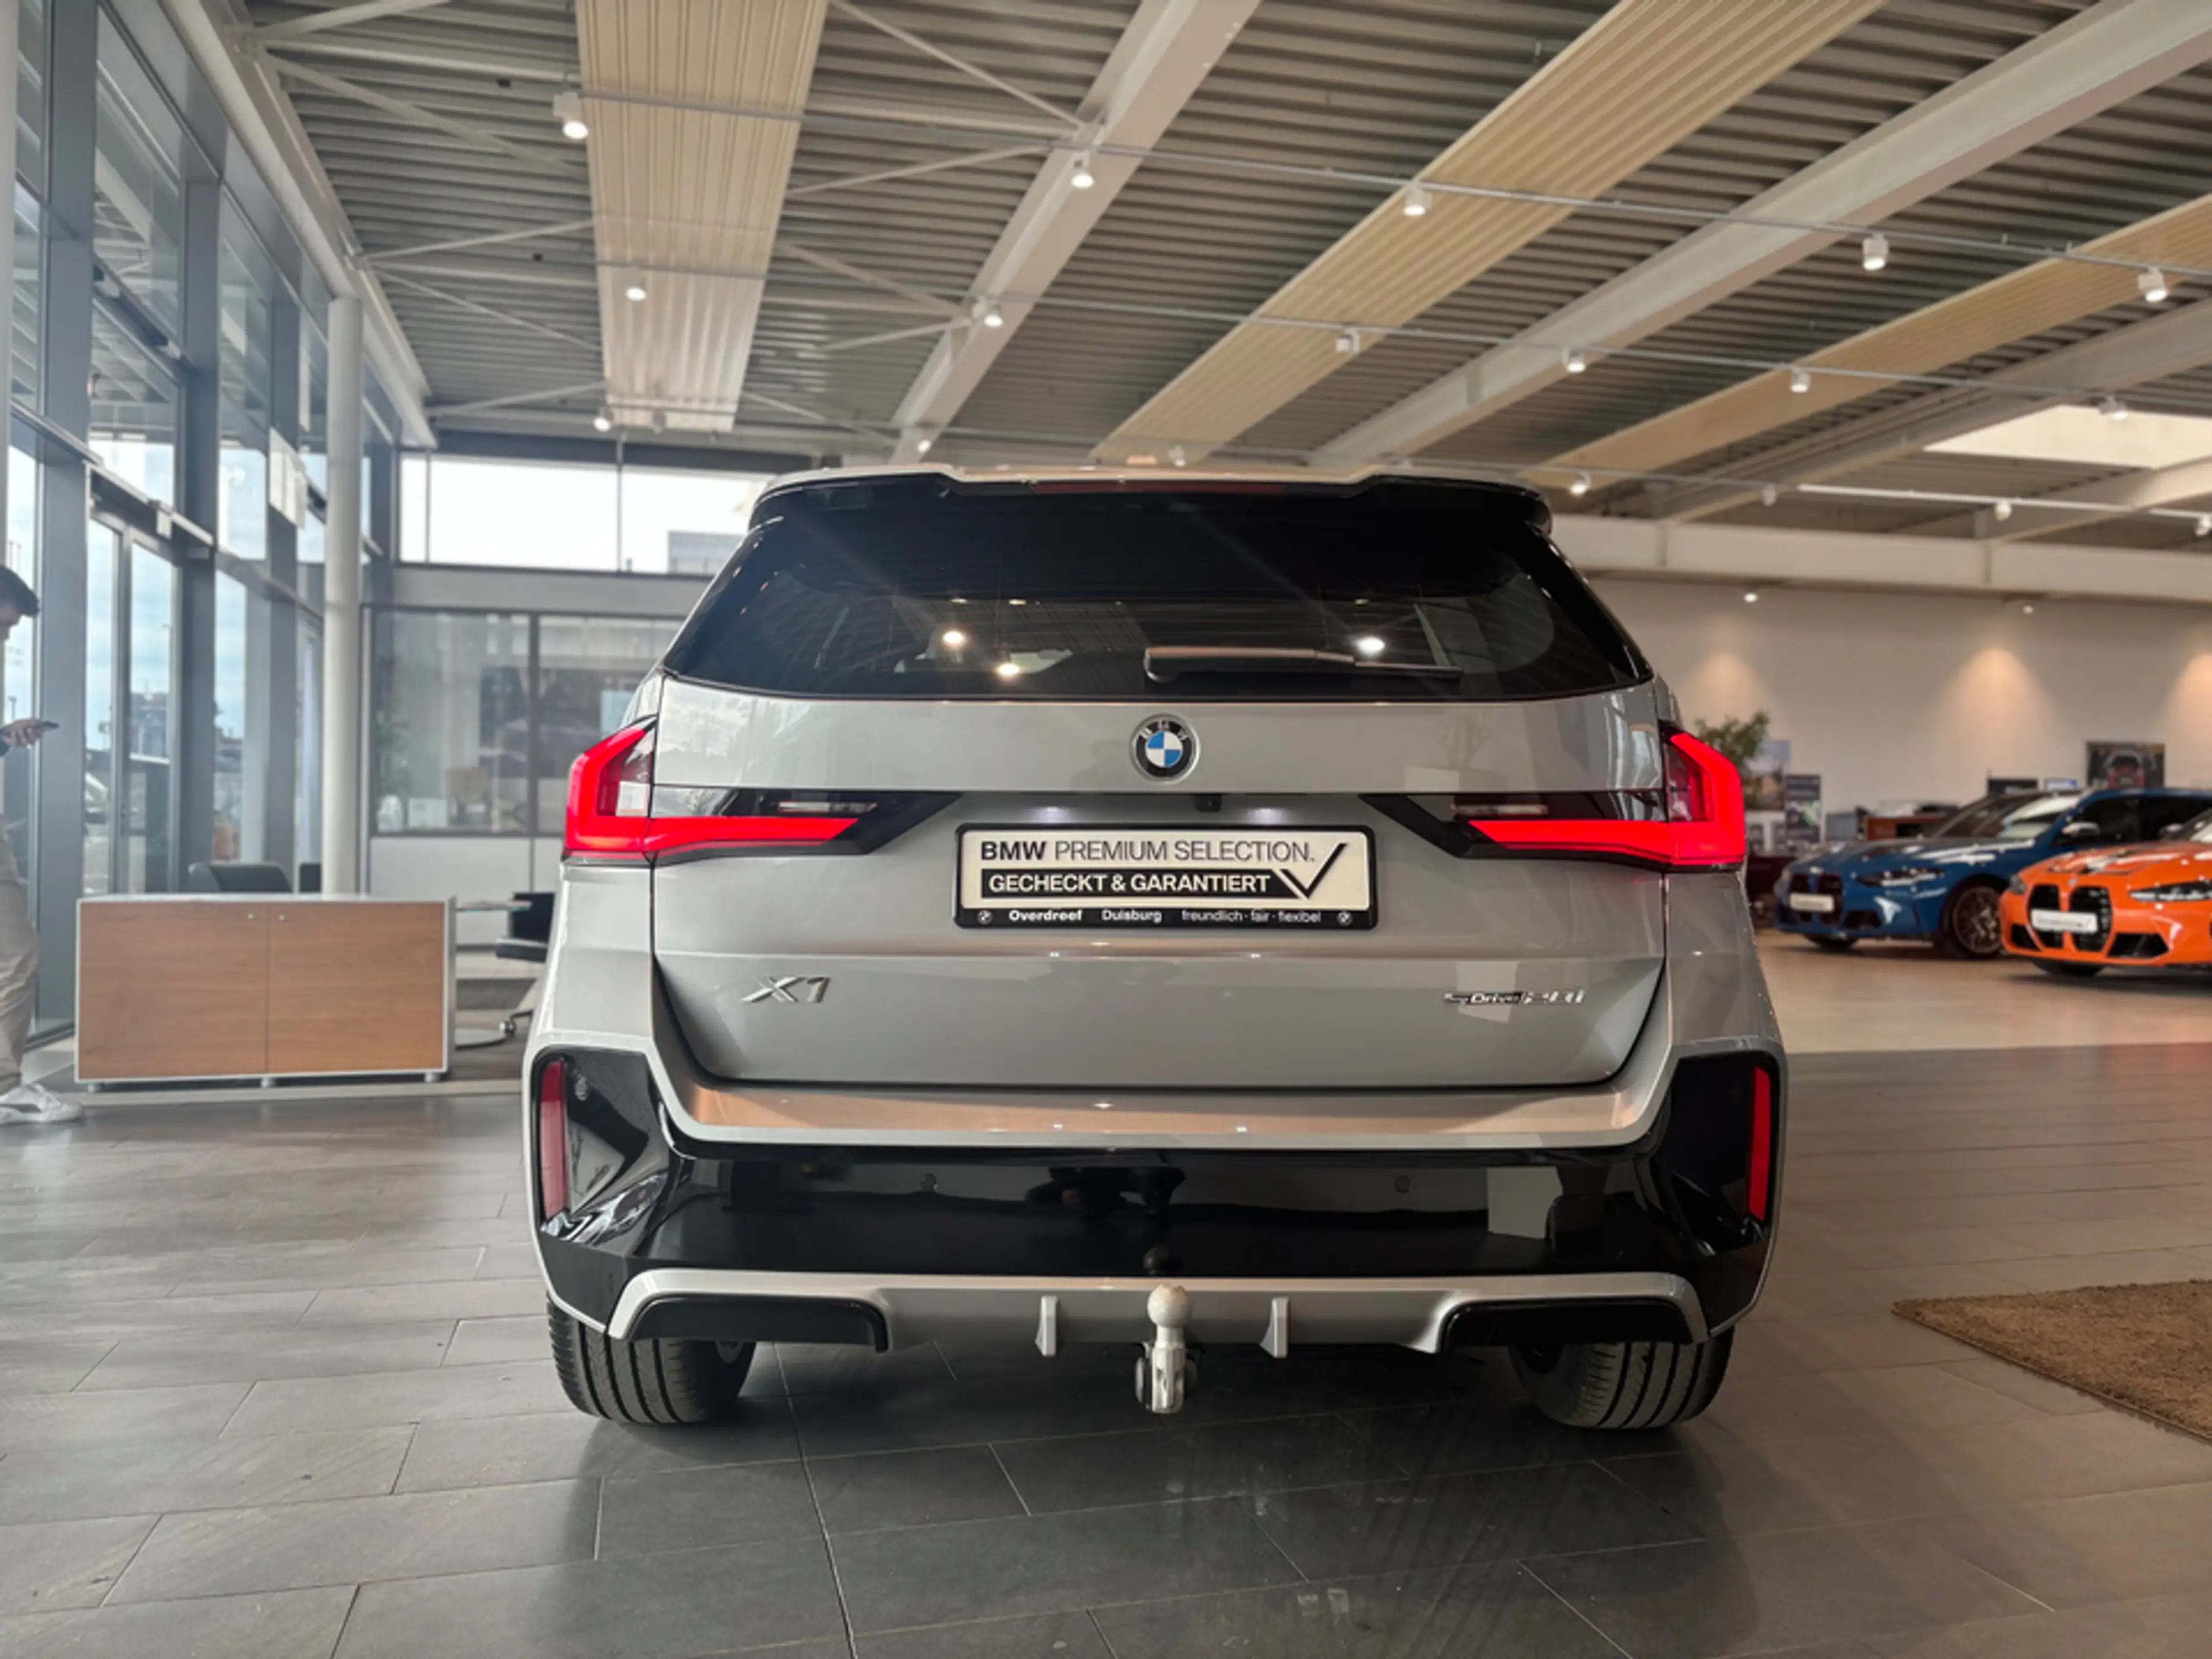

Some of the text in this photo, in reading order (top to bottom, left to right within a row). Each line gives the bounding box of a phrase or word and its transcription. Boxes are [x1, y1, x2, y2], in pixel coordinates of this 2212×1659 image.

[981, 840, 1316, 862] BMW PREMIUM SELECTION.
[988, 874, 1271, 892] GECHECKT & GARANTIERT
[1101, 910, 1162, 925] Duisburg
[1181, 910, 1243, 922] freundlich
[740, 976, 831, 1003] X1
